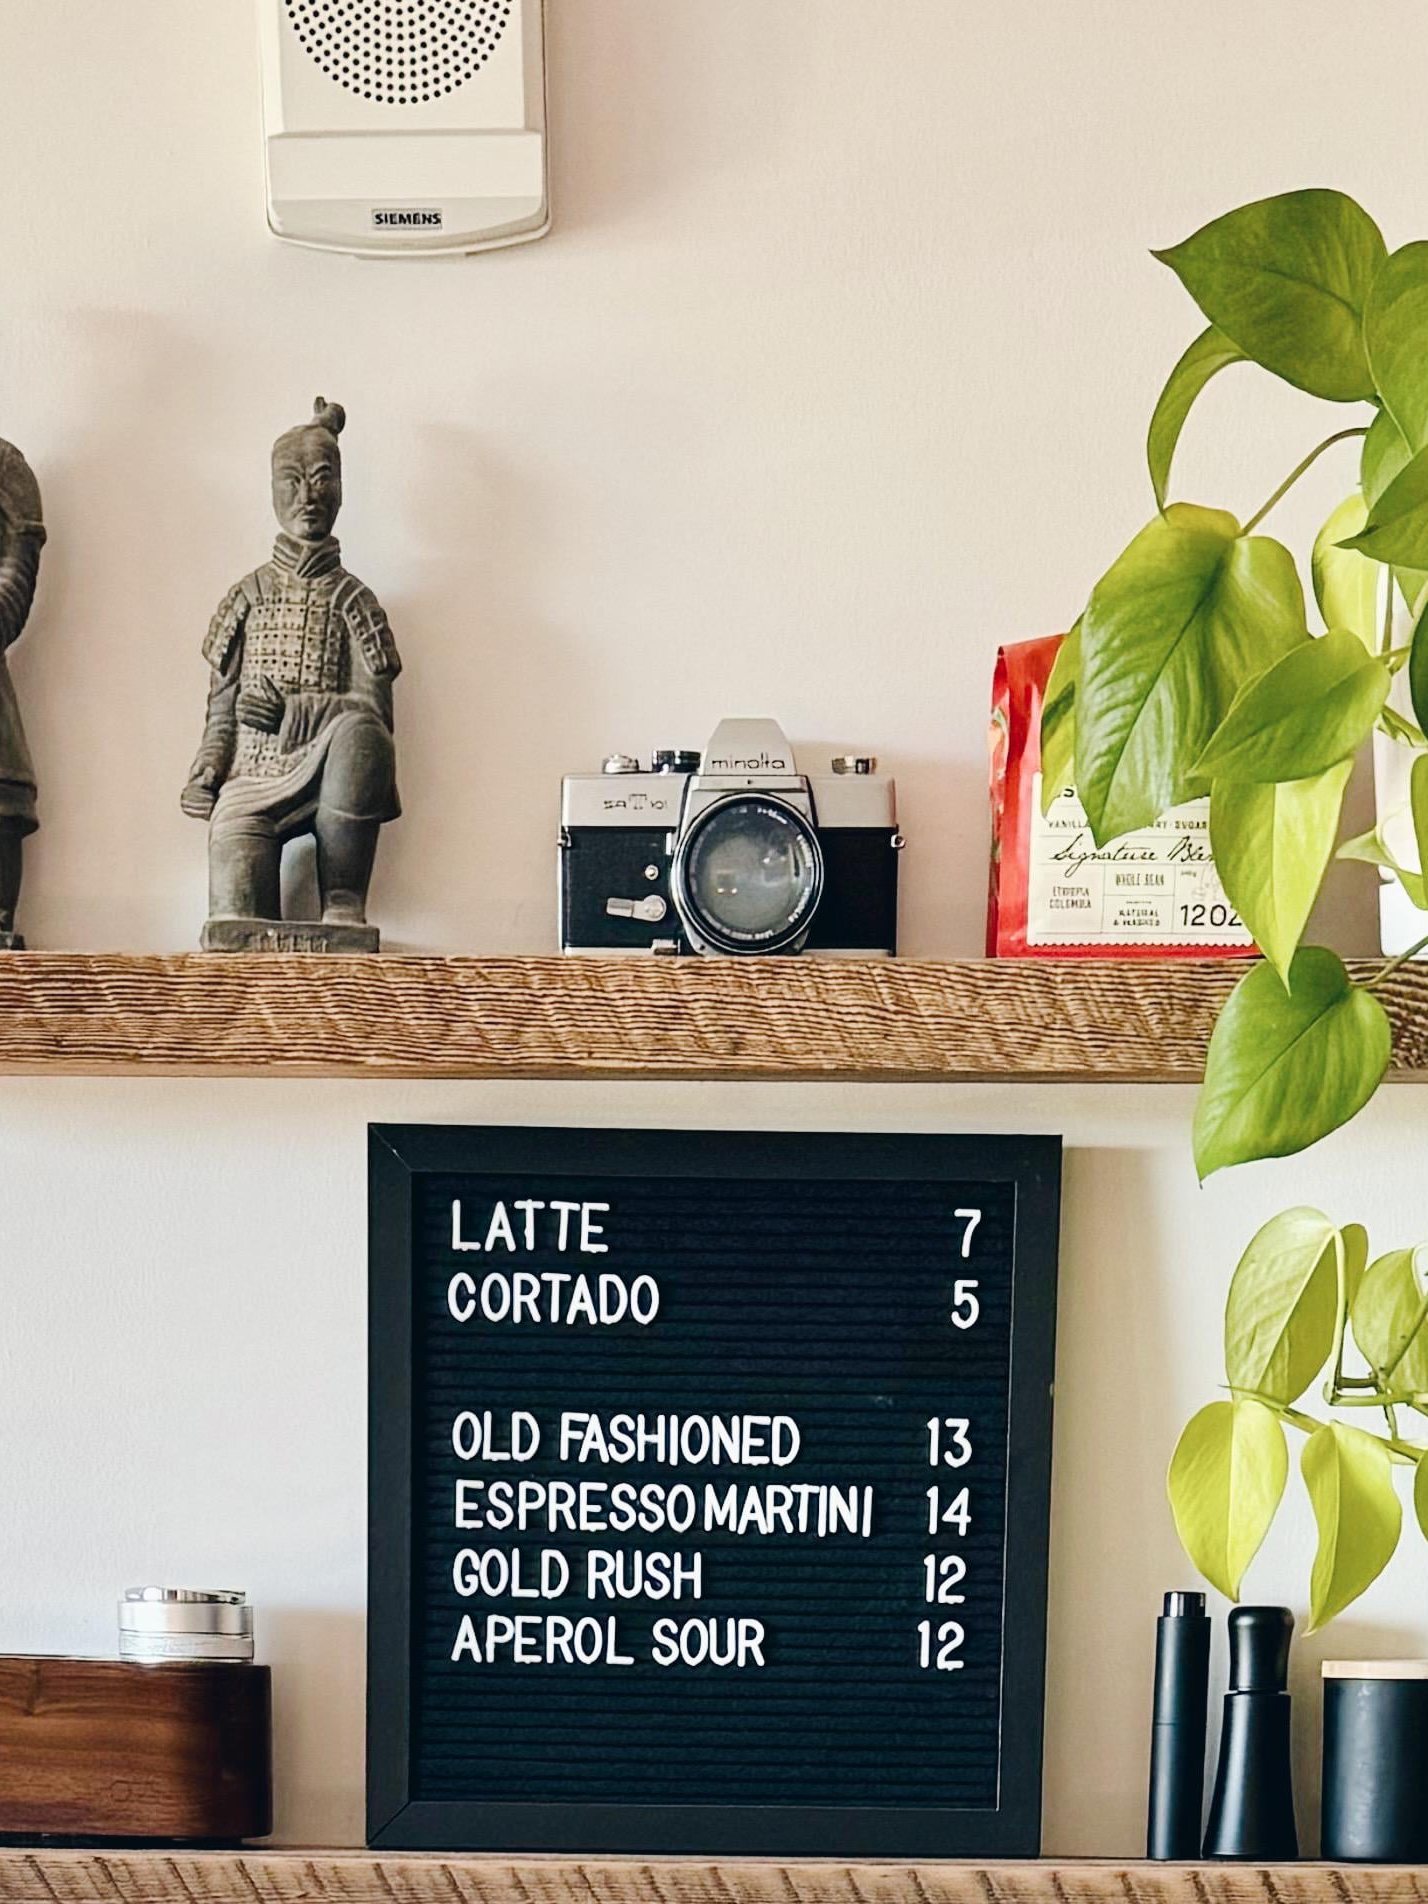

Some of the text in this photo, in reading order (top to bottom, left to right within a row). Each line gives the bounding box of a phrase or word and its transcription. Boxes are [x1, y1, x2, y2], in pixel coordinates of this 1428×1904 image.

[374, 212, 441, 225] SIEMENS
[711, 752, 786, 770] minolta
[1049, 833, 1158, 878] Signature
[452, 1199, 981, 1258] LATTE 7
[447, 1272, 979, 1329] CORTADO 5
[452, 1411, 973, 1469] OLD FASHIONED 13
[455, 1479, 972, 1538] ESPRESSO MARTINI 14
[452, 1548, 967, 1605] GOLD RUSH 12
[451, 1614, 965, 1671] APEROL SOUR 12
